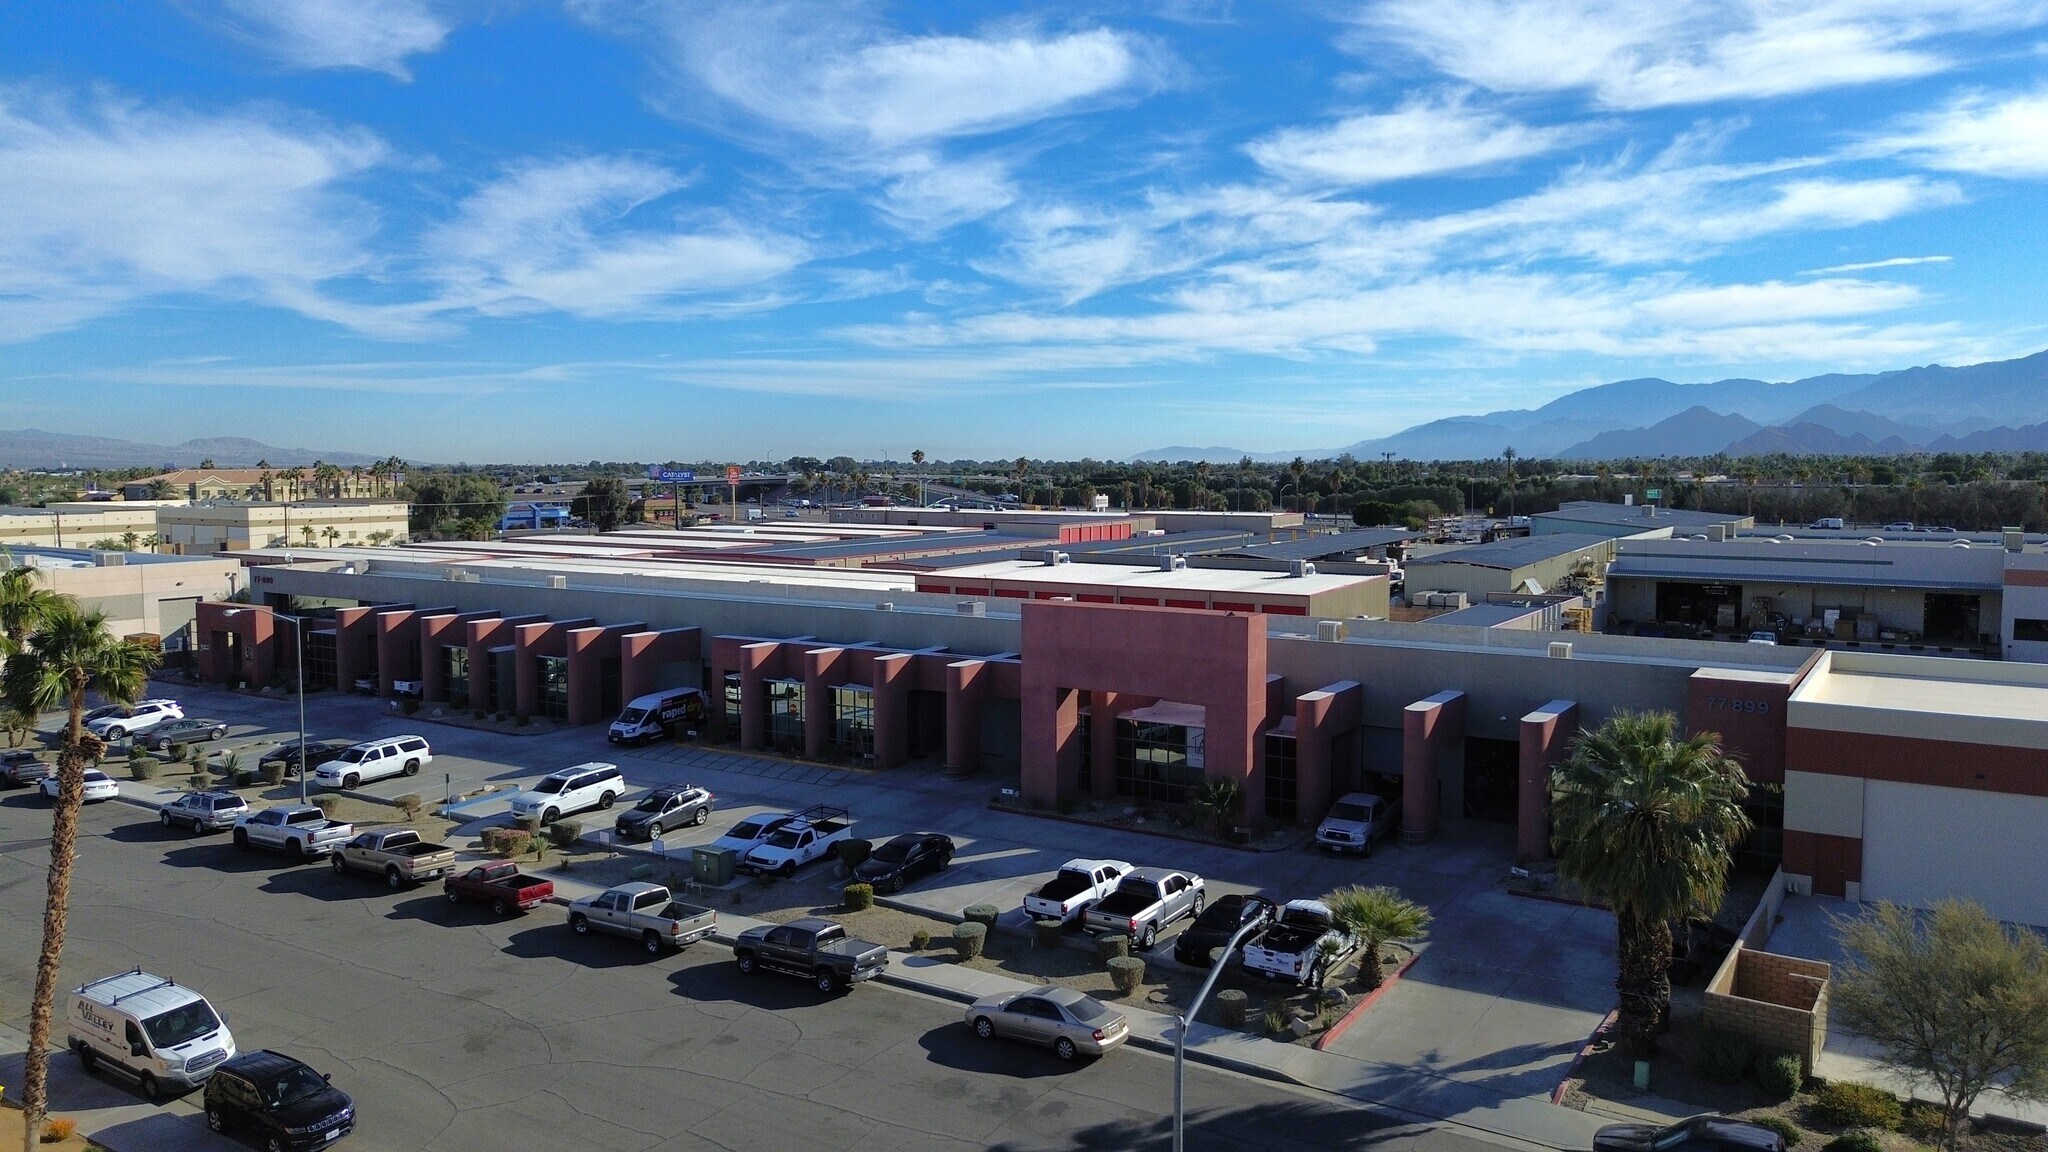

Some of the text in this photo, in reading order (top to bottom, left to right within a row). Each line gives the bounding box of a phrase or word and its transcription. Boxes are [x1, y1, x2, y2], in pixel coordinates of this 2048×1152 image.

[662, 704, 687, 719] rapid
[77, 1000, 95, 1014] ALL
[81, 1008, 114, 1031] VALLEY
